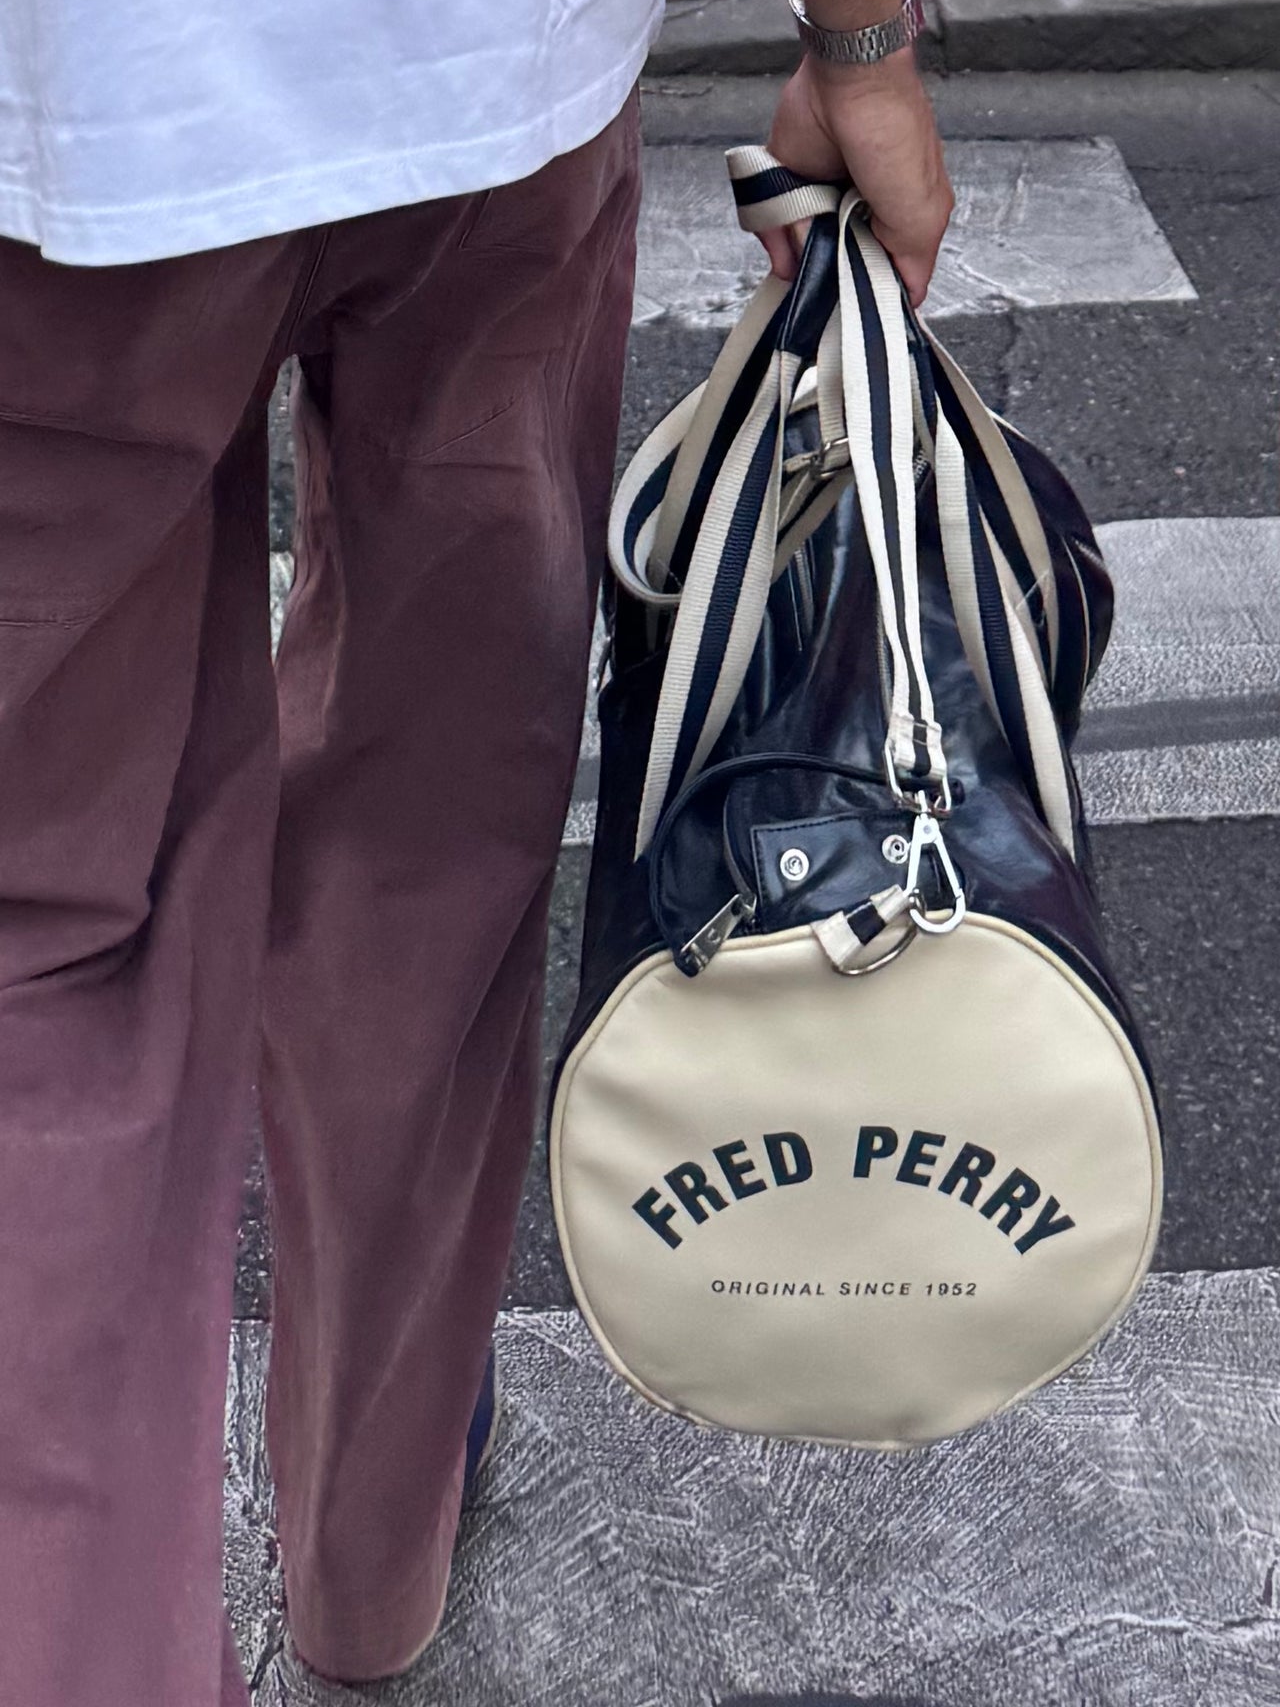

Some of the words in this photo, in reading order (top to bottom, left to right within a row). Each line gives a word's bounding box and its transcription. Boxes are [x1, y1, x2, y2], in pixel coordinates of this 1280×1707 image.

[632, 1131, 813, 1250] FRED
[853, 1125, 1076, 1255] PERRY
[711, 1279, 825, 1297] ORIGINAL
[838, 1281, 912, 1297] SINCE
[925, 1282, 978, 1297] 1952
